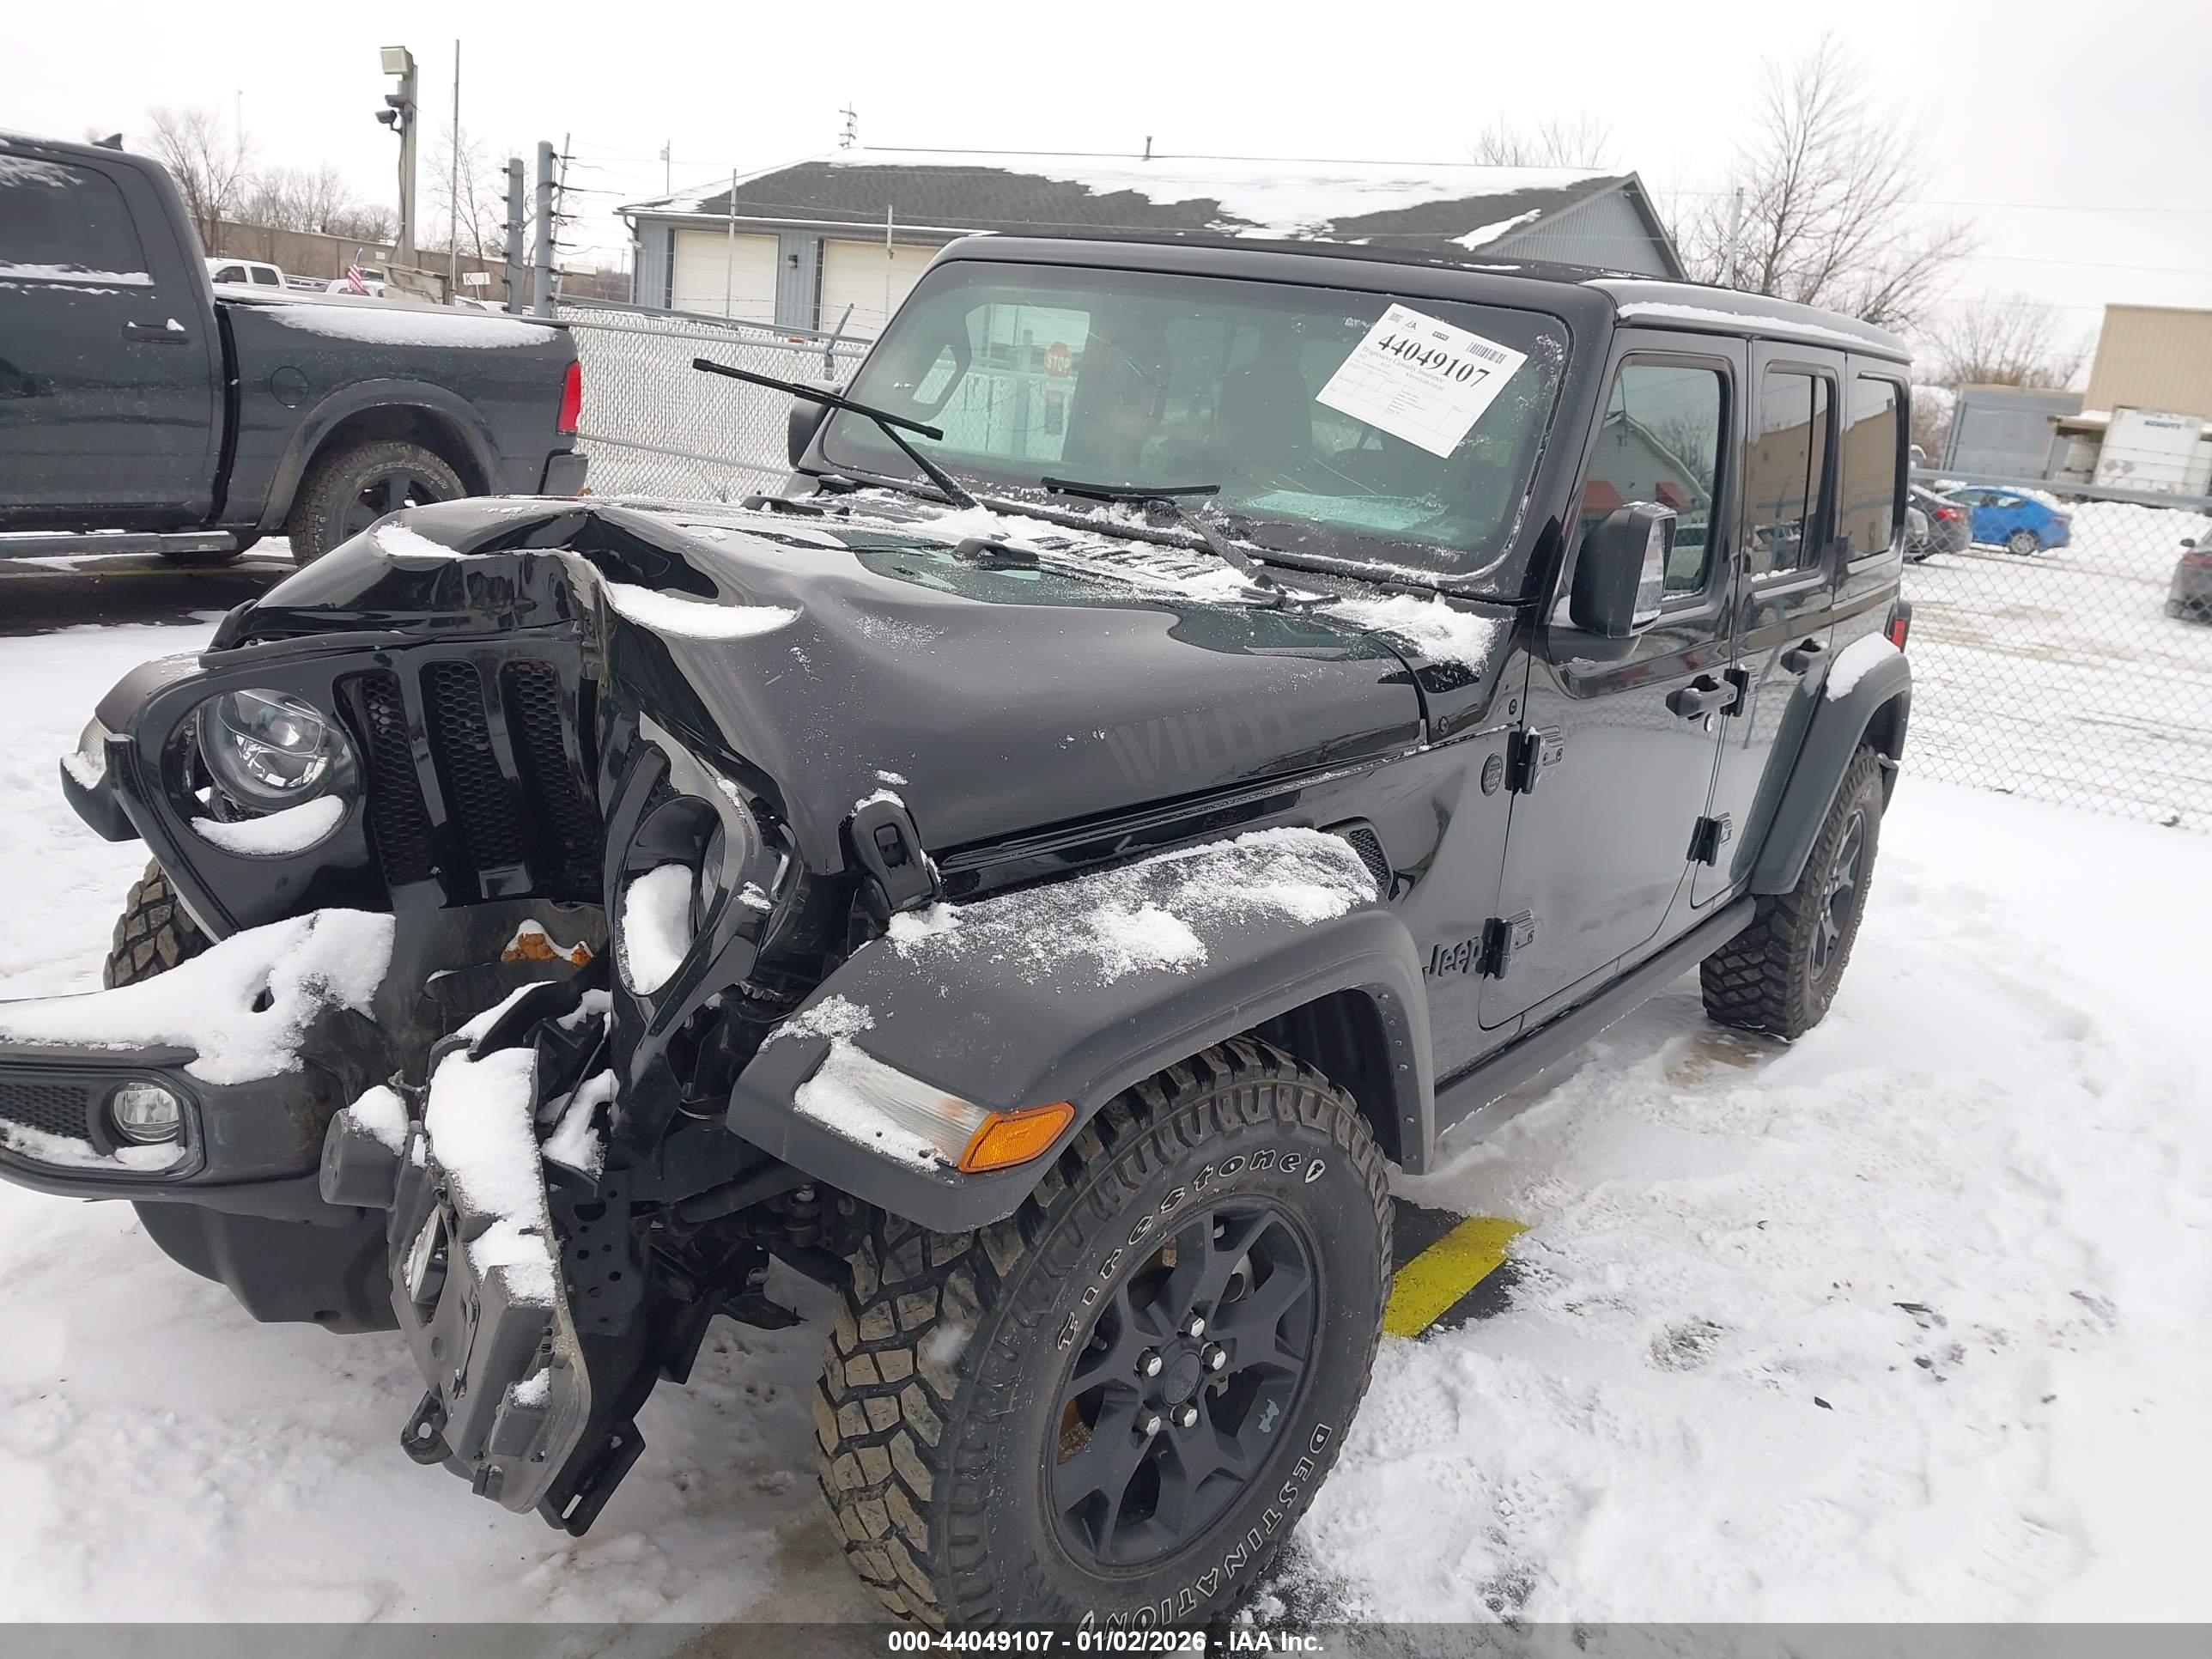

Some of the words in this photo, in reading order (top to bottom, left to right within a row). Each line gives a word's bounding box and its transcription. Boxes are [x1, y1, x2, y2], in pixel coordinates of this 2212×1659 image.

[1047, 354, 1071, 373] STOP
[1377, 333, 1491, 387] 44049107
[1422, 935, 1484, 985] Jeep
[1057, 1149, 1302, 1351] Firestone
[1103, 1423, 1332, 1641] DESTINATION
